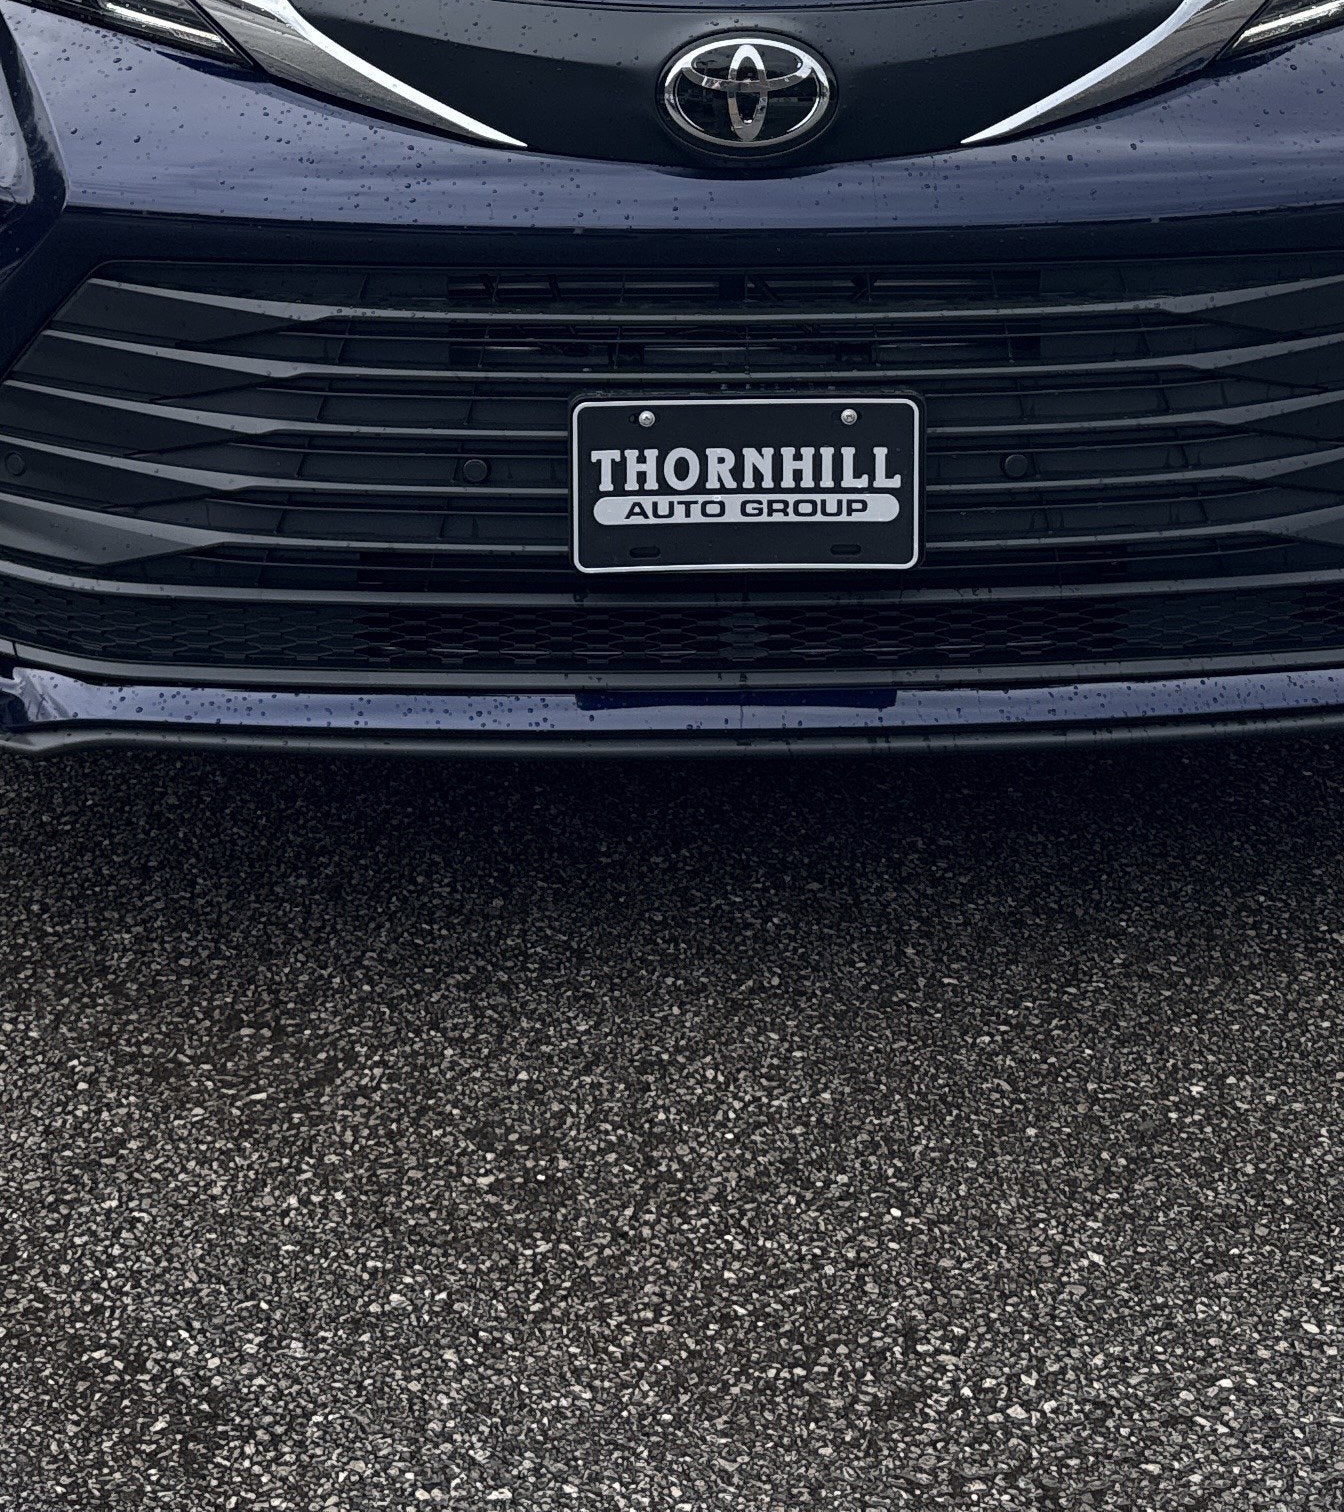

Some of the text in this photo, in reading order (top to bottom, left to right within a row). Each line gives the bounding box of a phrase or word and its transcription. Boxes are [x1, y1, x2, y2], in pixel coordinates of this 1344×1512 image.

[591, 446, 901, 492] THORNHILL
[623, 498, 869, 520] AUTO GROUP
